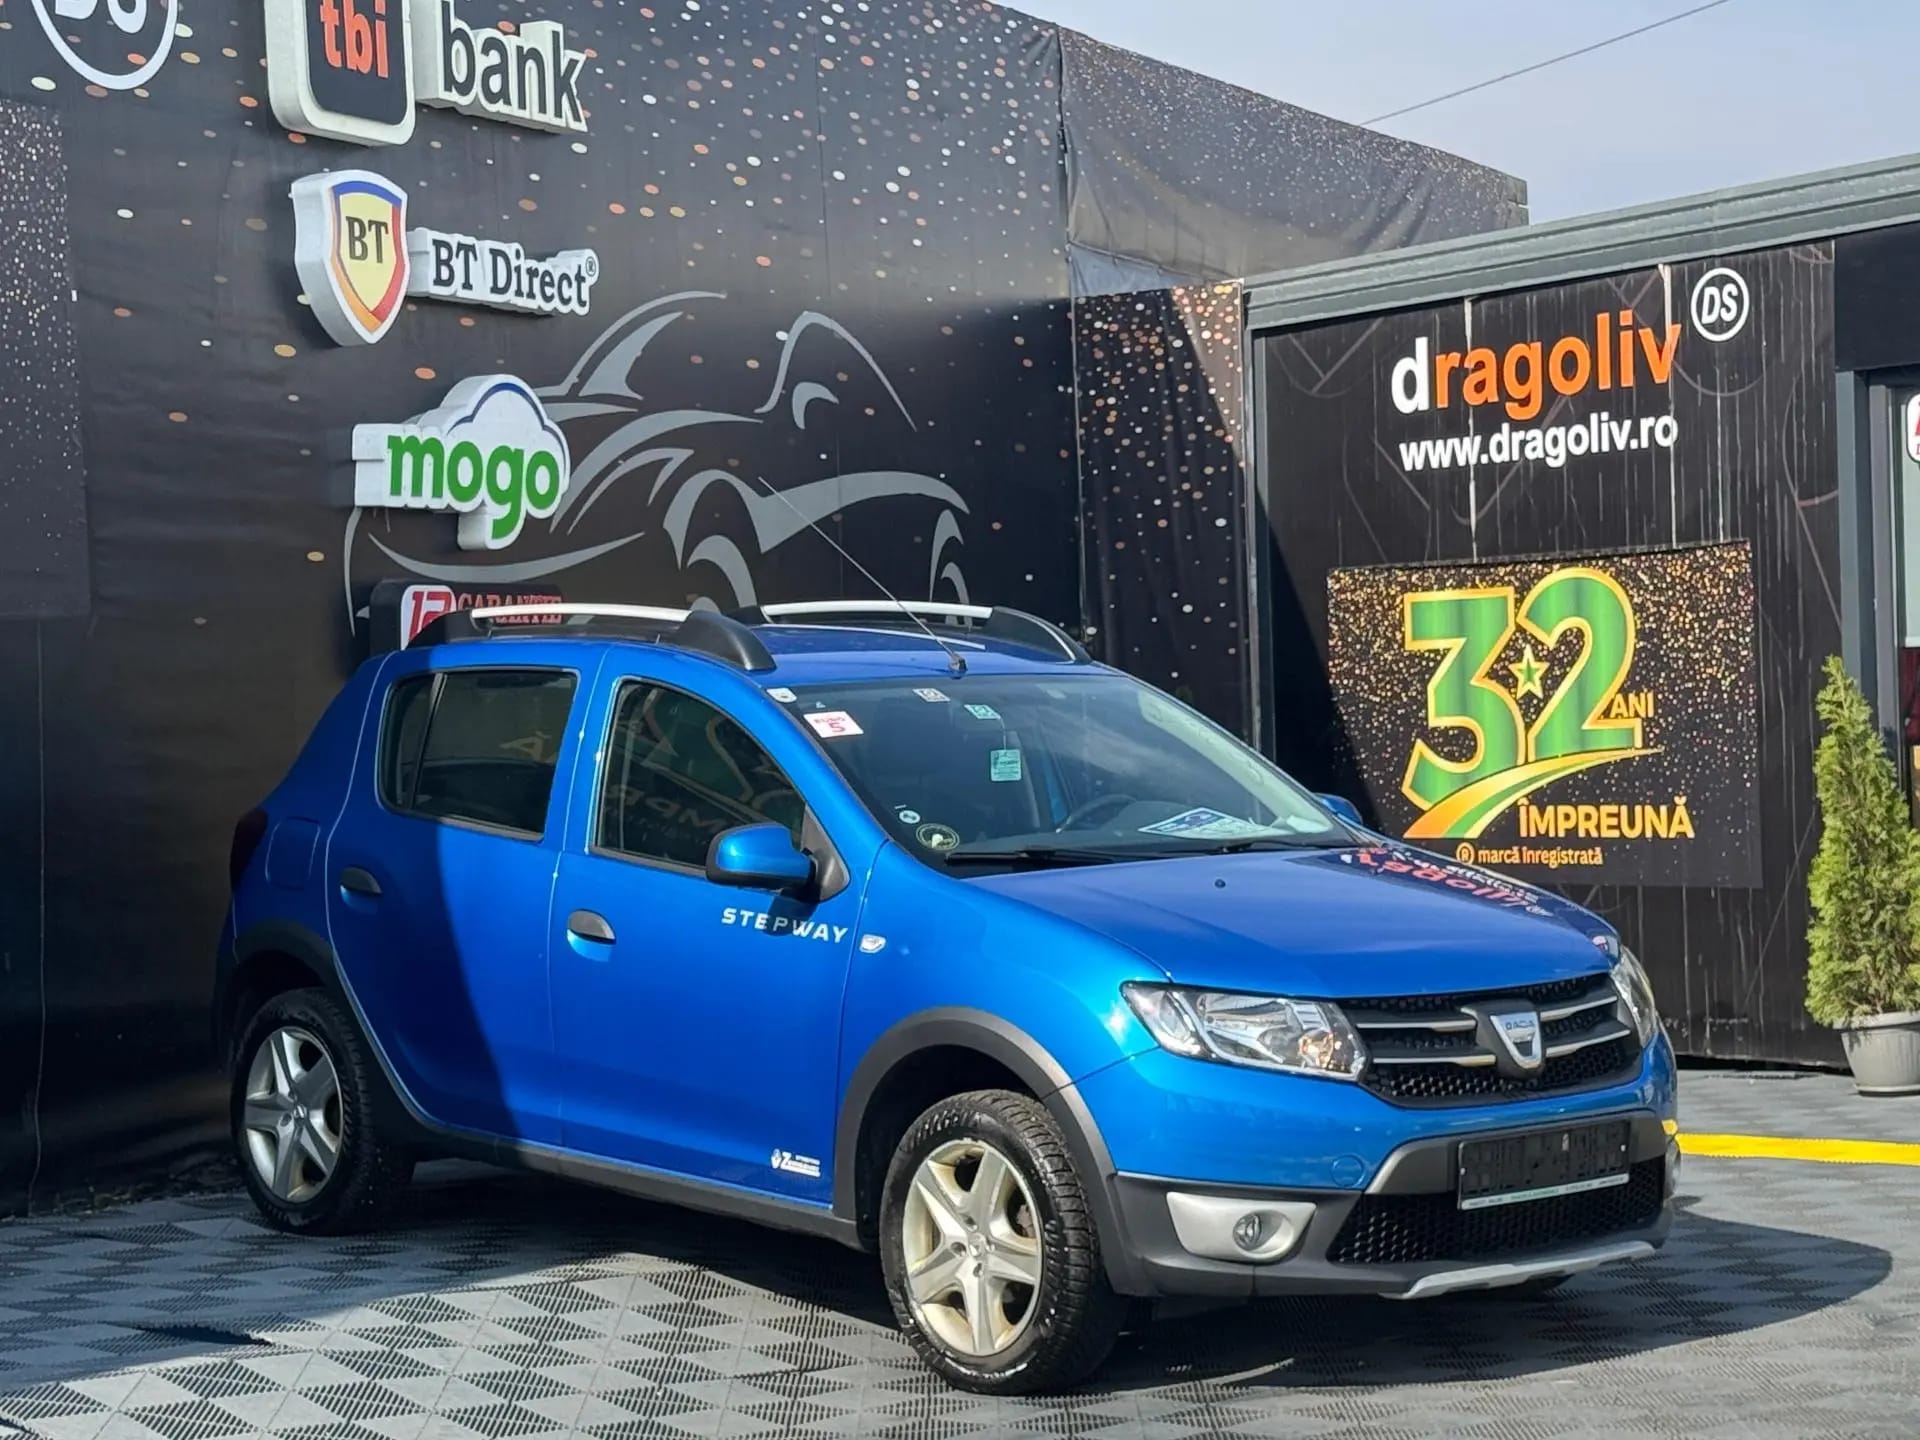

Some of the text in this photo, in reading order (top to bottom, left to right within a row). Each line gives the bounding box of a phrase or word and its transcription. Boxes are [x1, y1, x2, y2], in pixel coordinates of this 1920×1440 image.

[321, 0, 389, 78] tbi
[443, 0, 585, 125] bank
[346, 216, 389, 264] BT
[433, 239, 478, 291] BT
[1701, 283, 1738, 325] DS
[1391, 309, 1682, 421] dragoliv
[1400, 412, 1679, 470] www.dragoliv.ro
[387, 435, 560, 540] mogo
[1401, 567, 1644, 811] 32
[1609, 691, 1655, 719] ANI
[1518, 796, 1695, 839] ÎMPREUNĂ
[1478, 846, 1520, 864] marcă
[1522, 846, 1604, 869] înregistrată
[721, 907, 848, 943] STEPWAY
